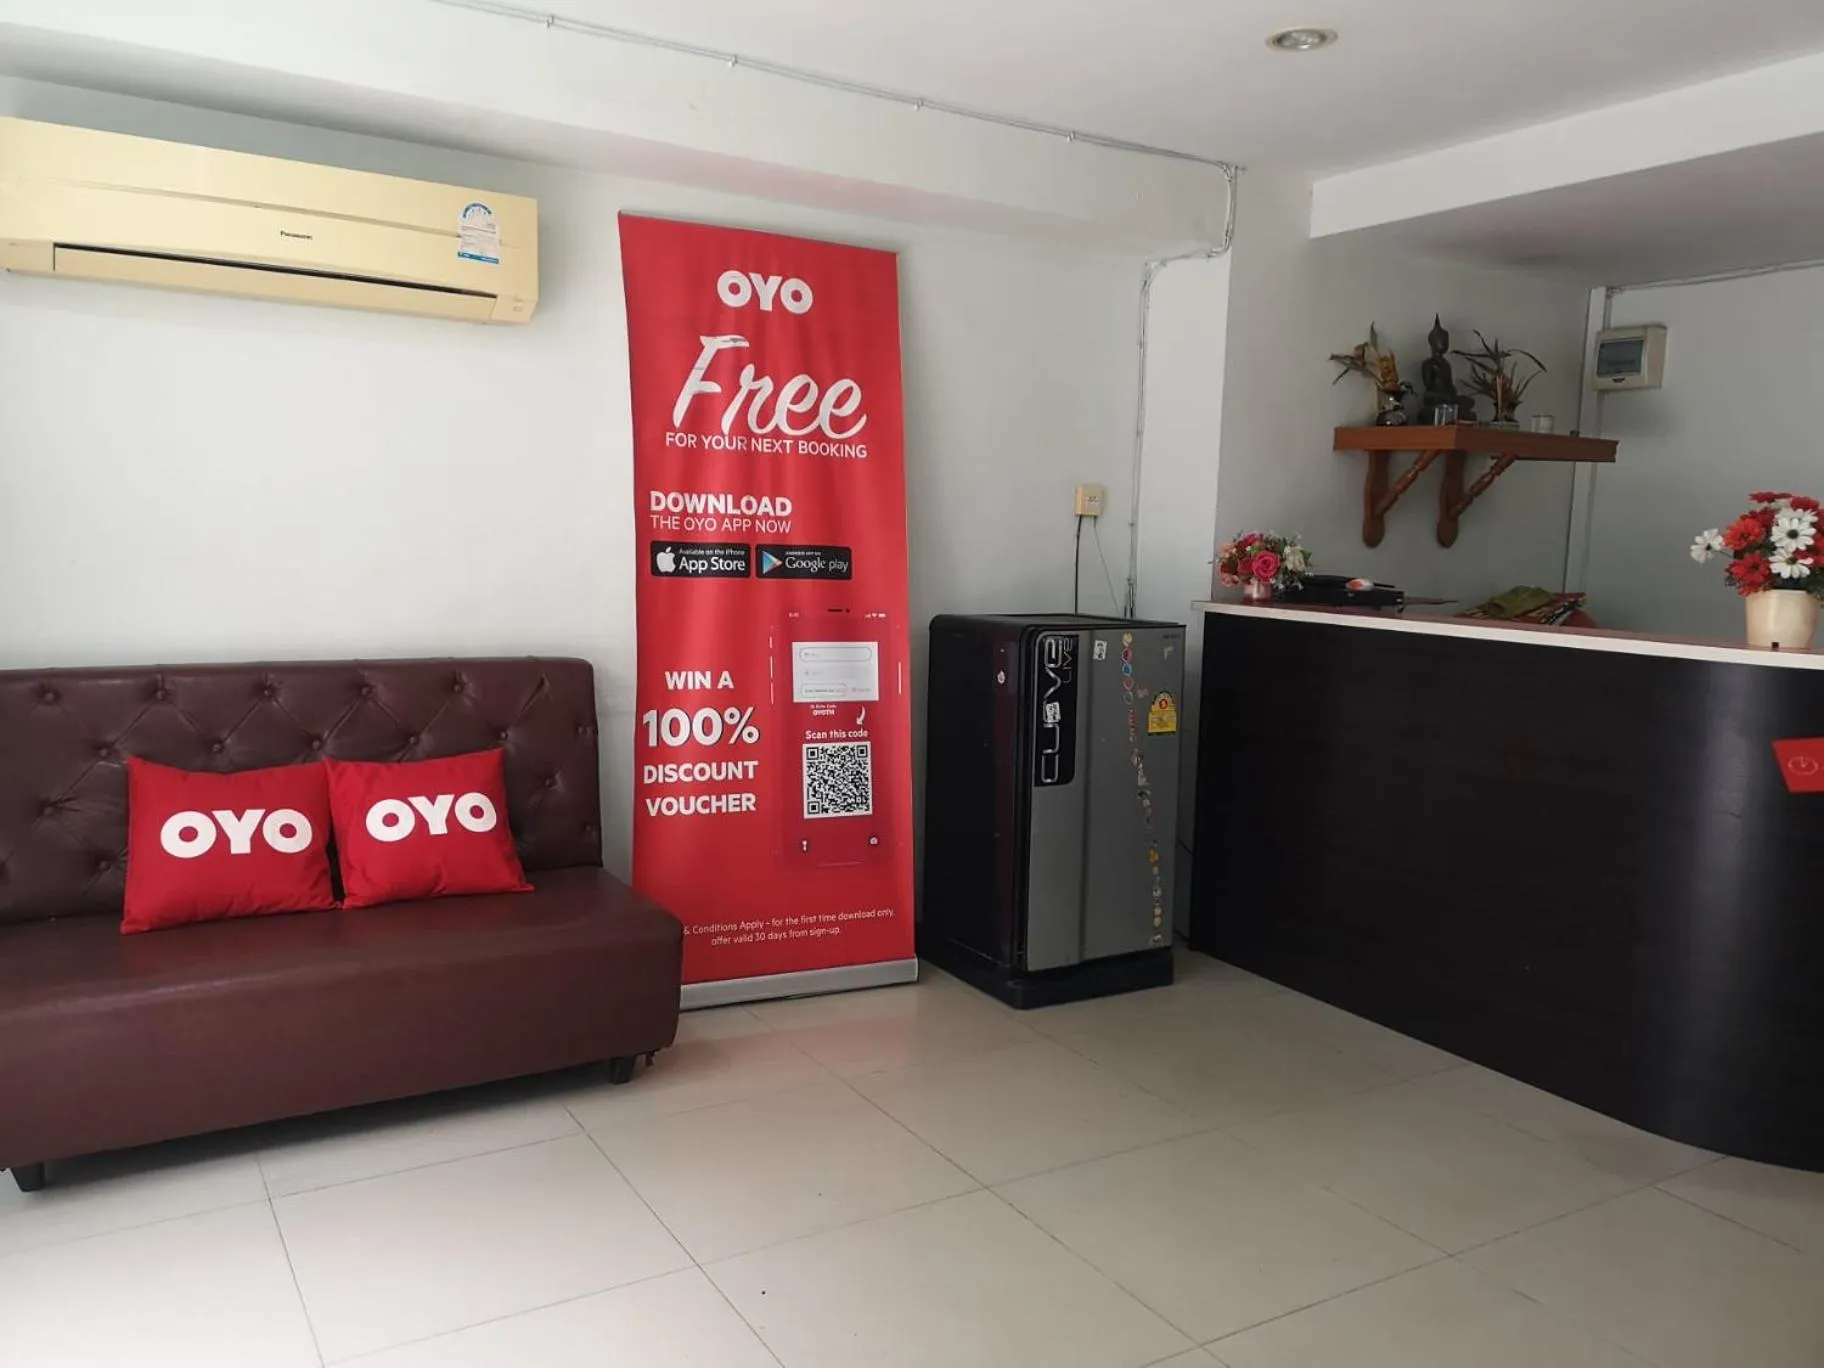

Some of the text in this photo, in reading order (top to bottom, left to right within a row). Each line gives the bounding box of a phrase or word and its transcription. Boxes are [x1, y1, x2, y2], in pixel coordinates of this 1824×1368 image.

[717, 270, 813, 314] OYO
[673, 334, 867, 439] Free
[666, 432, 868, 458] FOR YOUR NEXT BOOKING
[650, 490, 793, 517] DOWNLOAD
[650, 515, 792, 534] THE OYO APP NOW
[679, 556, 746, 574] App Store
[785, 556, 849, 573] Google play
[665, 671, 735, 690] WIN A
[642, 707, 760, 747] 100%
[805, 727, 868, 740] Scan this code
[643, 761, 759, 784] DISCOUNT
[645, 793, 757, 816] VOUCHER
[365, 792, 497, 843] OYO
[160, 808, 312, 859] OYO
[684, 926, 690, 935] &
[692, 922, 738, 934] Conditions
[739, 920, 764, 931] Apply
[771, 918, 783, 926] for
[785, 916, 799, 926] the
[800, 914, 817, 924] first
[818, 913, 837, 922] time
[838, 909, 876, 921] download
[711, 936, 732, 946] offer
[733, 933, 754, 943] valid
[755, 931, 766, 941] 30
[767, 929, 788, 941] days
[789, 927, 808, 938] from
